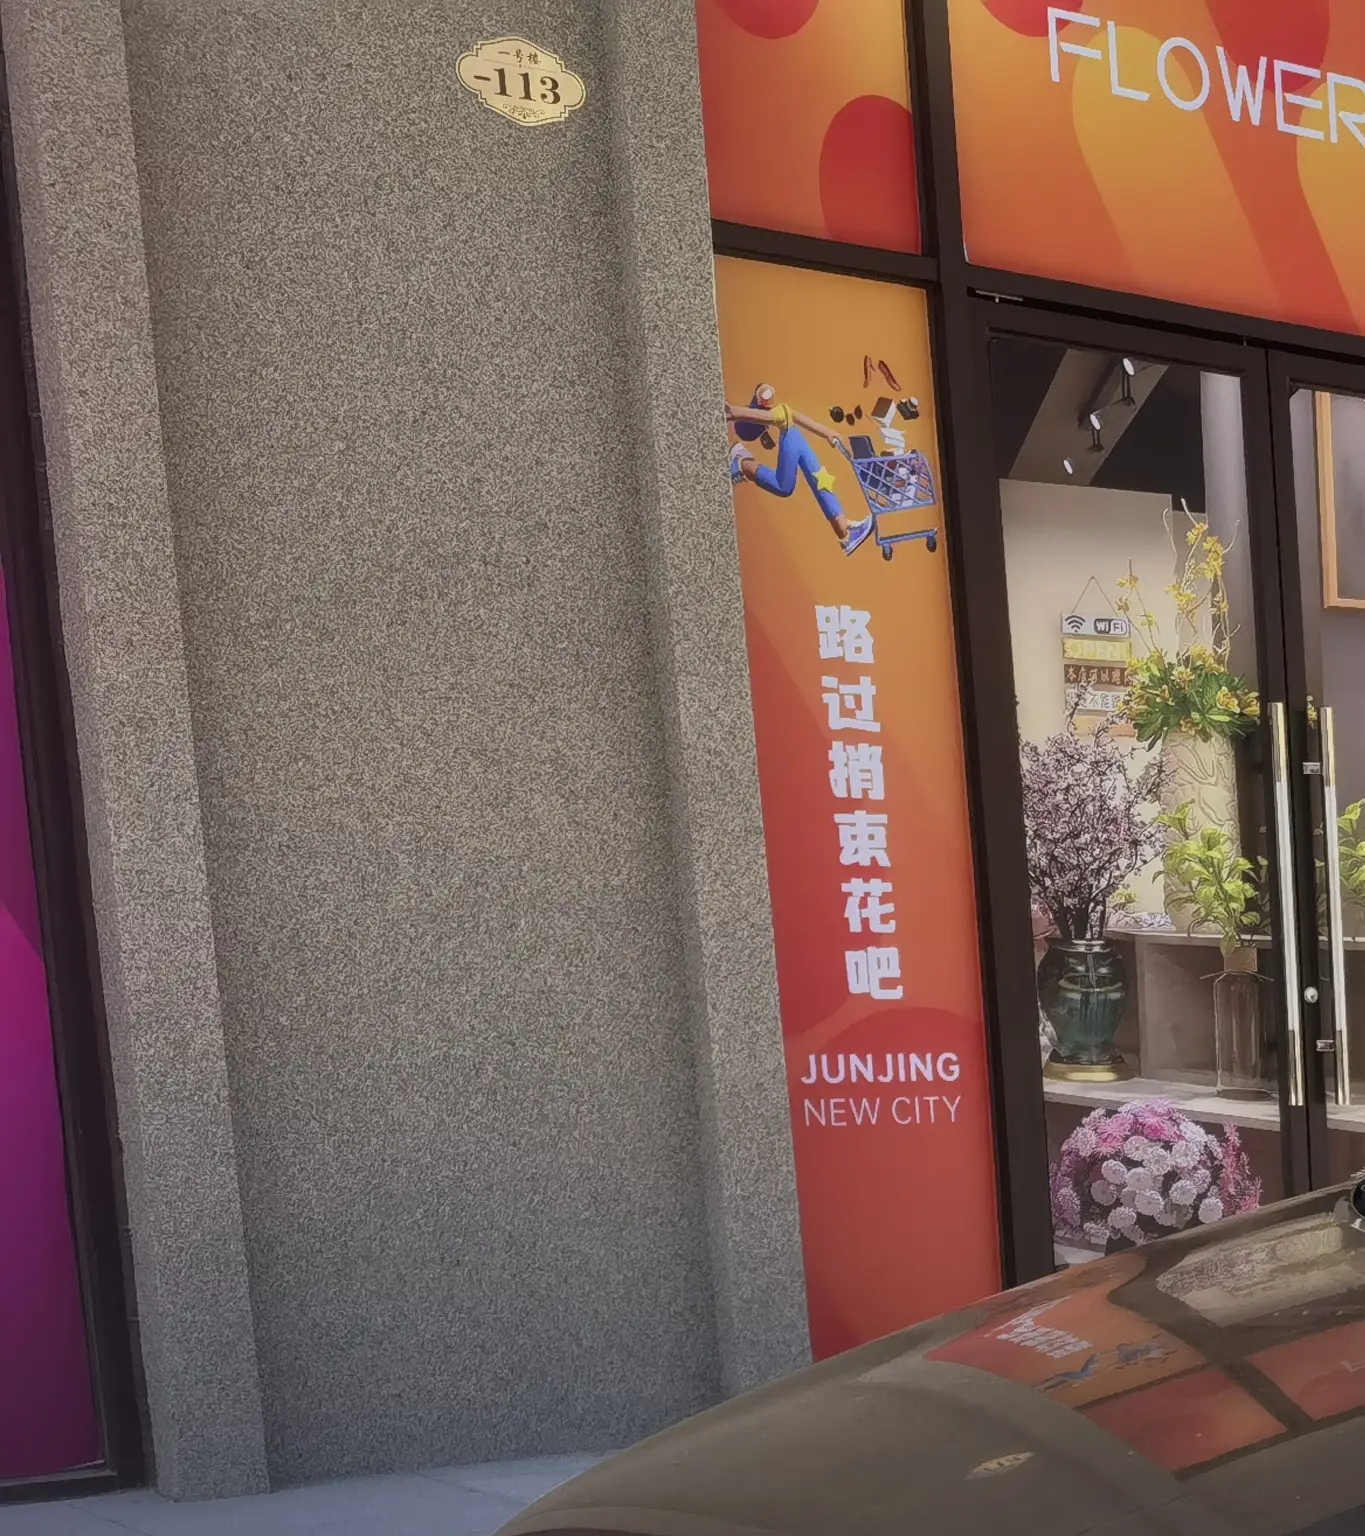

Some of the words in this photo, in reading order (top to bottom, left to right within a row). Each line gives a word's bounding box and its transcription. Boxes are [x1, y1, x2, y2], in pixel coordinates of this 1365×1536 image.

[473, 67, 561, 105] -113
[814, 604, 905, 1001] 路过捎束花吧
[800, 1051, 961, 1087] JUNJING
[803, 1096, 886, 1127] NEW
[891, 1094, 962, 1125] CITY
